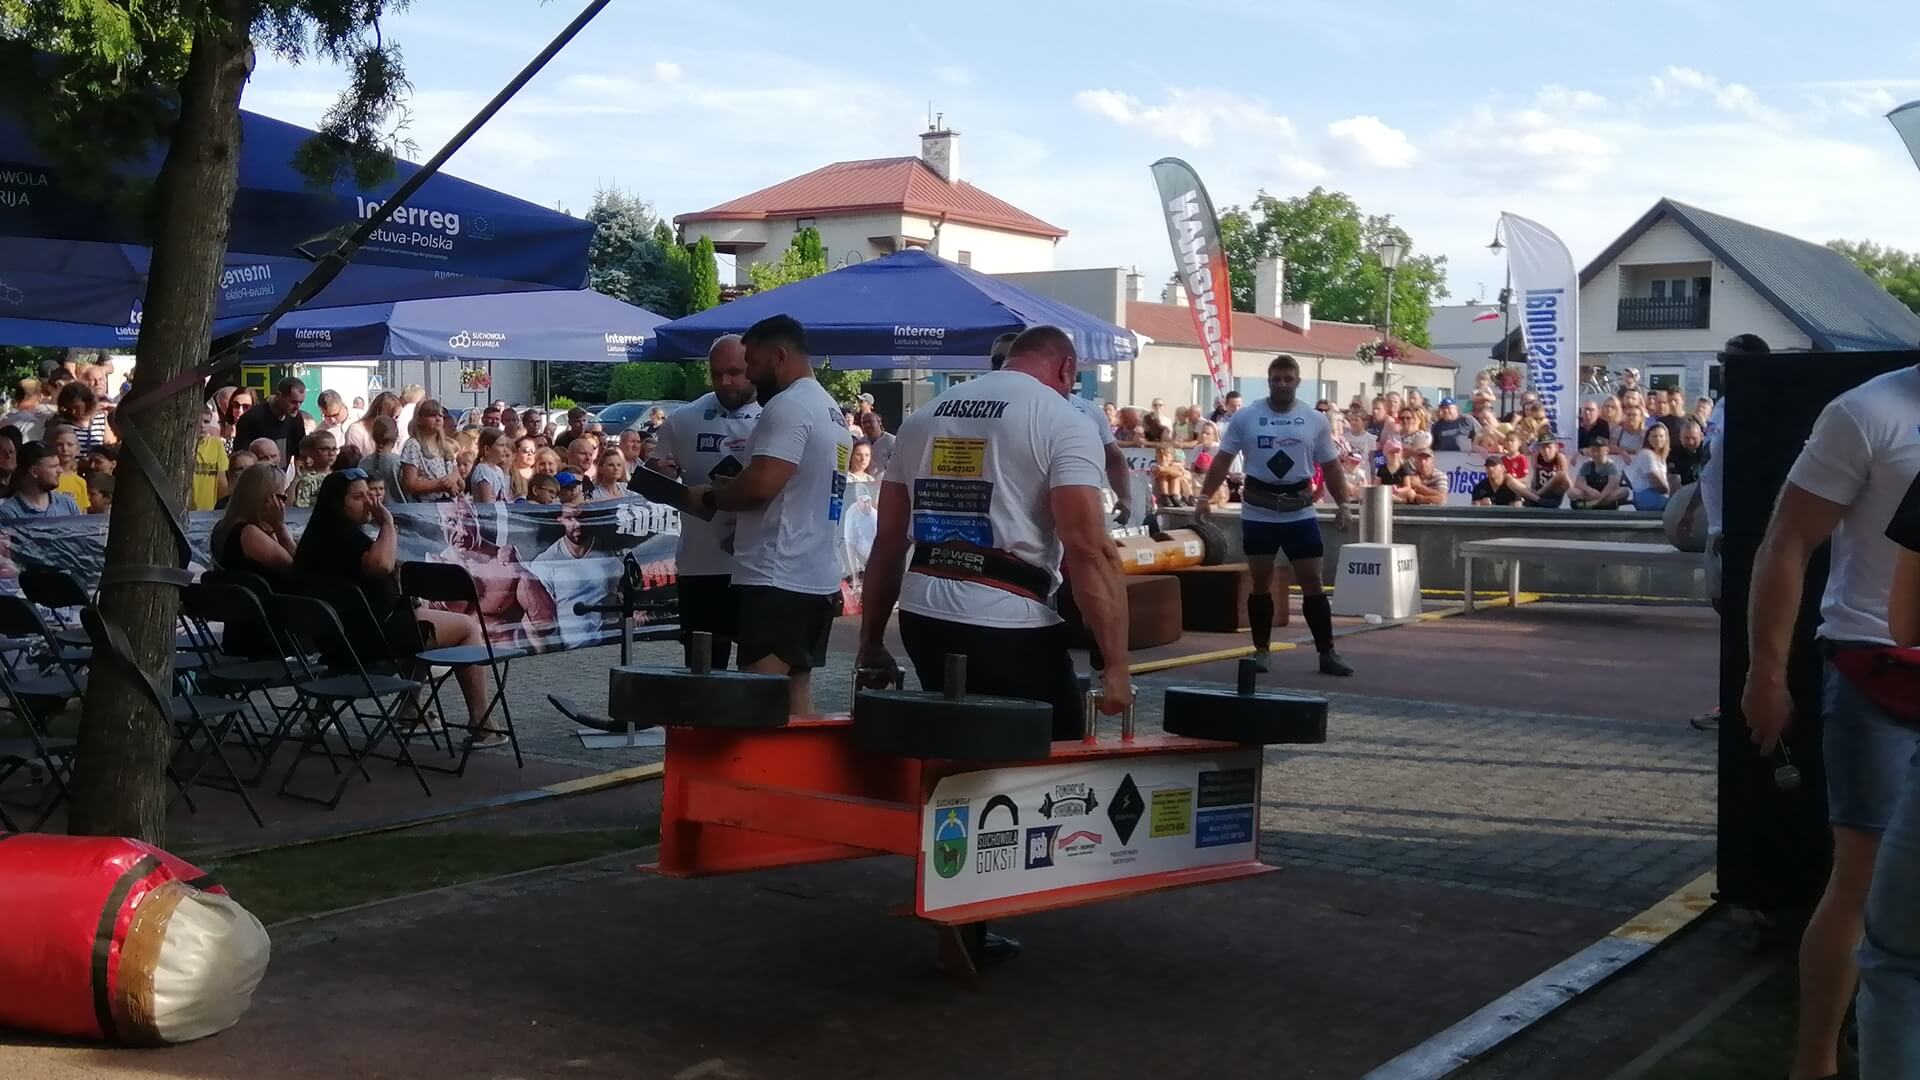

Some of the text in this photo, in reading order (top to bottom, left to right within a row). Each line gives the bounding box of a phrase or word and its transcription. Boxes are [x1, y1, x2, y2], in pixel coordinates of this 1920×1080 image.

[0, 170, 48, 187] WOLA
[356, 195, 460, 235] Inerreg
[295, 328, 331, 340] Interreg
[472, 332, 506, 341] SUCHOWOLA
[894, 325, 945, 338] Interreg
[471, 340, 500, 349] KALVARIJA
[604, 332, 645, 346] Interreg
[933, 400, 1010, 419] BŁASZCZYK
[1348, 561, 1382, 576] START
[1397, 559, 1414, 573] START
[978, 831, 1018, 847] SUCHOWOLA
[1030, 832, 1048, 865] psb
